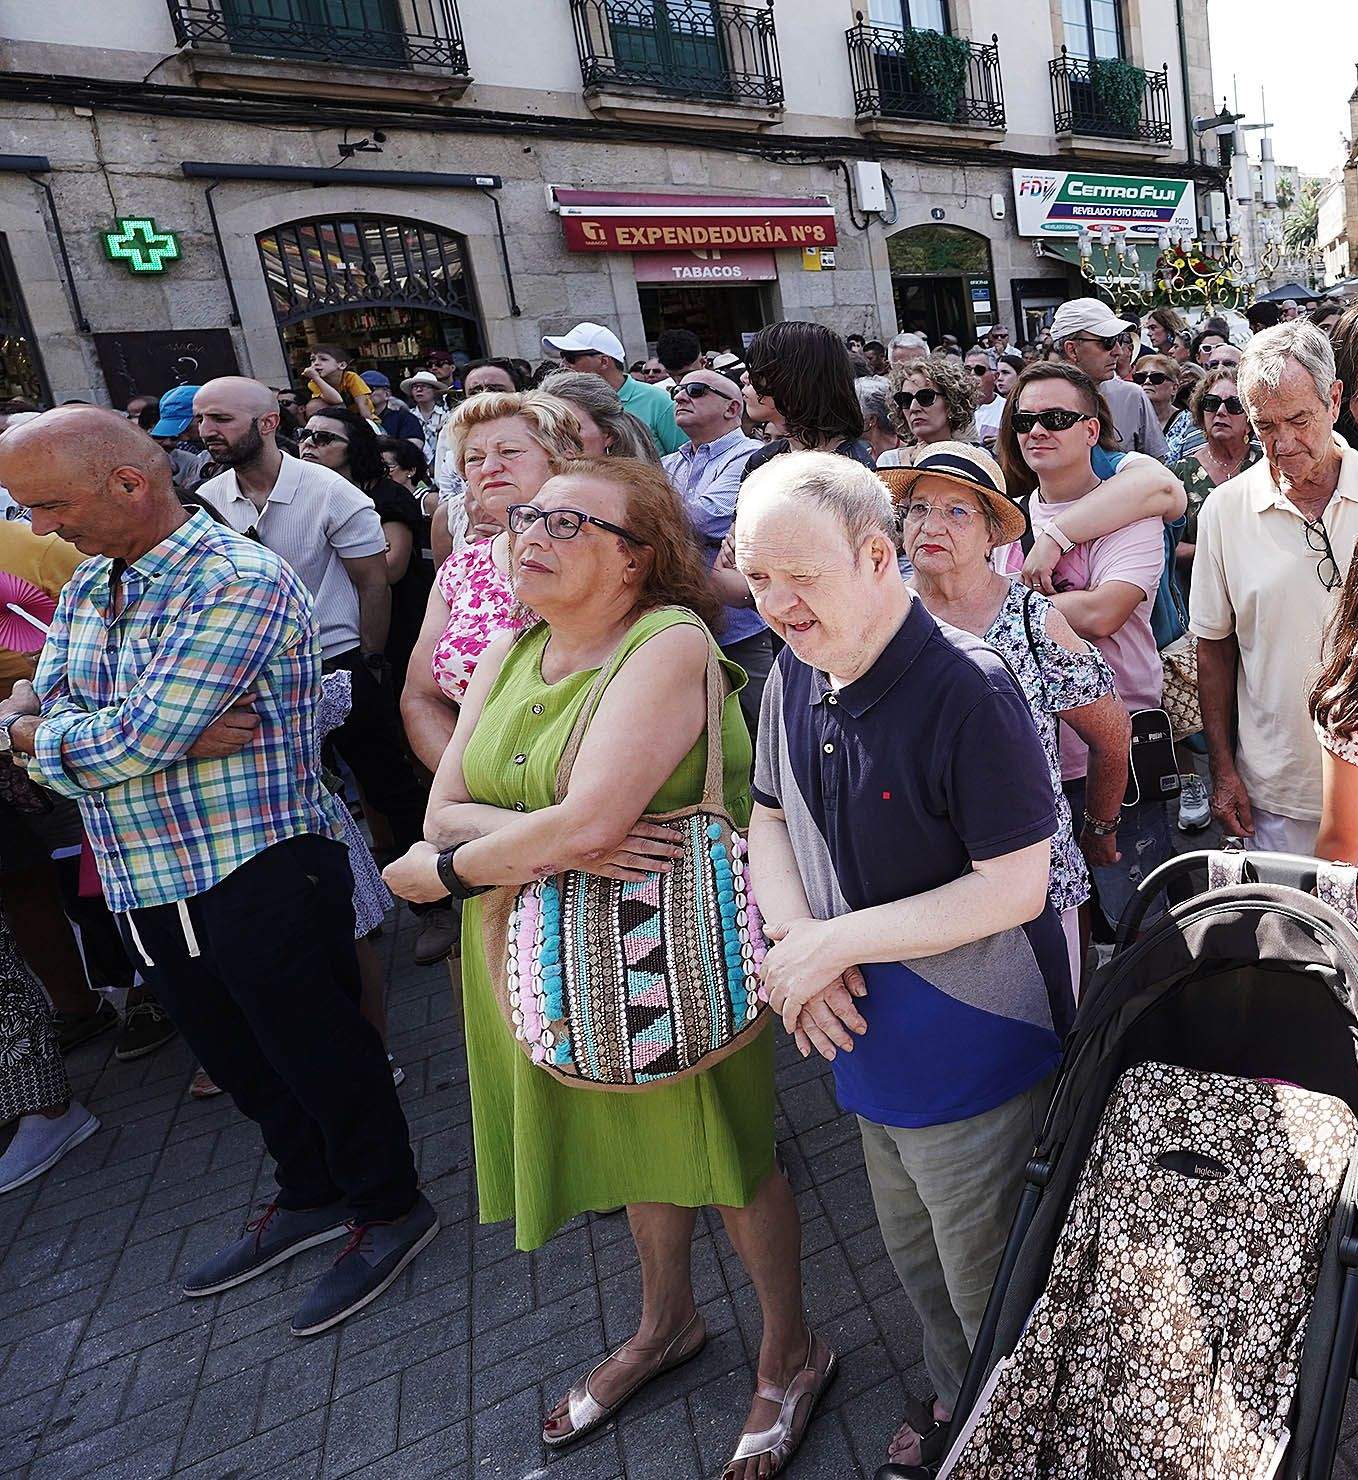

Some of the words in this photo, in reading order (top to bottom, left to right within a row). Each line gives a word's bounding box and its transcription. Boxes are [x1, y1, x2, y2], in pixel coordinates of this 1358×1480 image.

[1139, 185, 1176, 201] FUJI
[1072, 206, 1112, 217] REVELADO
[1112, 207, 1132, 217] FOTO
[1132, 208, 1159, 218] DIGITAL
[615, 221, 788, 245] EXPENDEDURÍA
[671, 265, 743, 279] TABACOS
